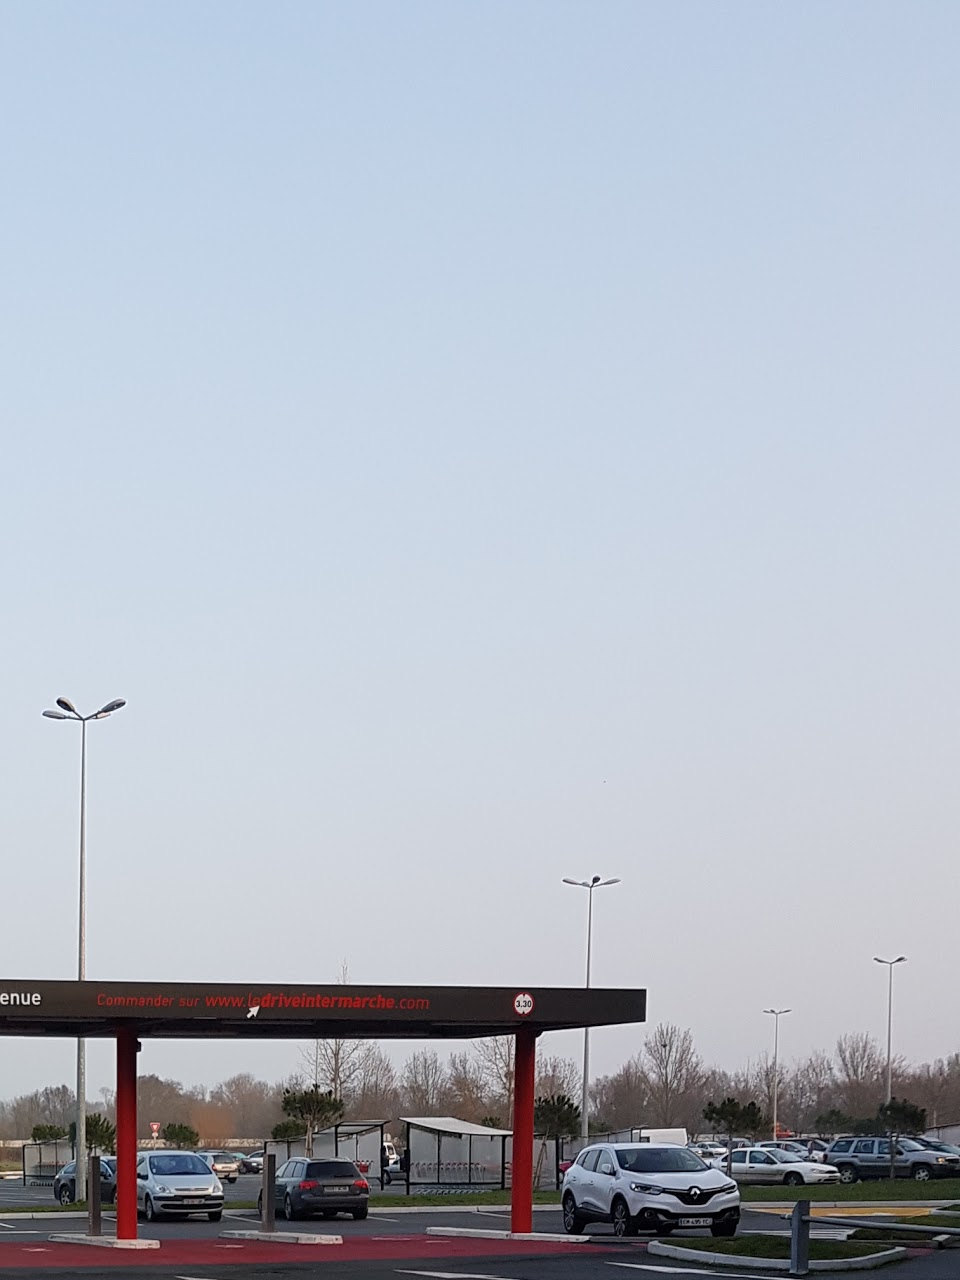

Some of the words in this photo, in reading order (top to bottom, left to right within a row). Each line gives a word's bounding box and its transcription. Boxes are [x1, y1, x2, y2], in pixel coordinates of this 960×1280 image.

[97, 993, 174, 1007] Commander
[179, 997, 200, 1007] sur
[205, 992, 430, 1010] www.ledriveintermarche.com
[515, 1000, 532, 1008] 3.30
